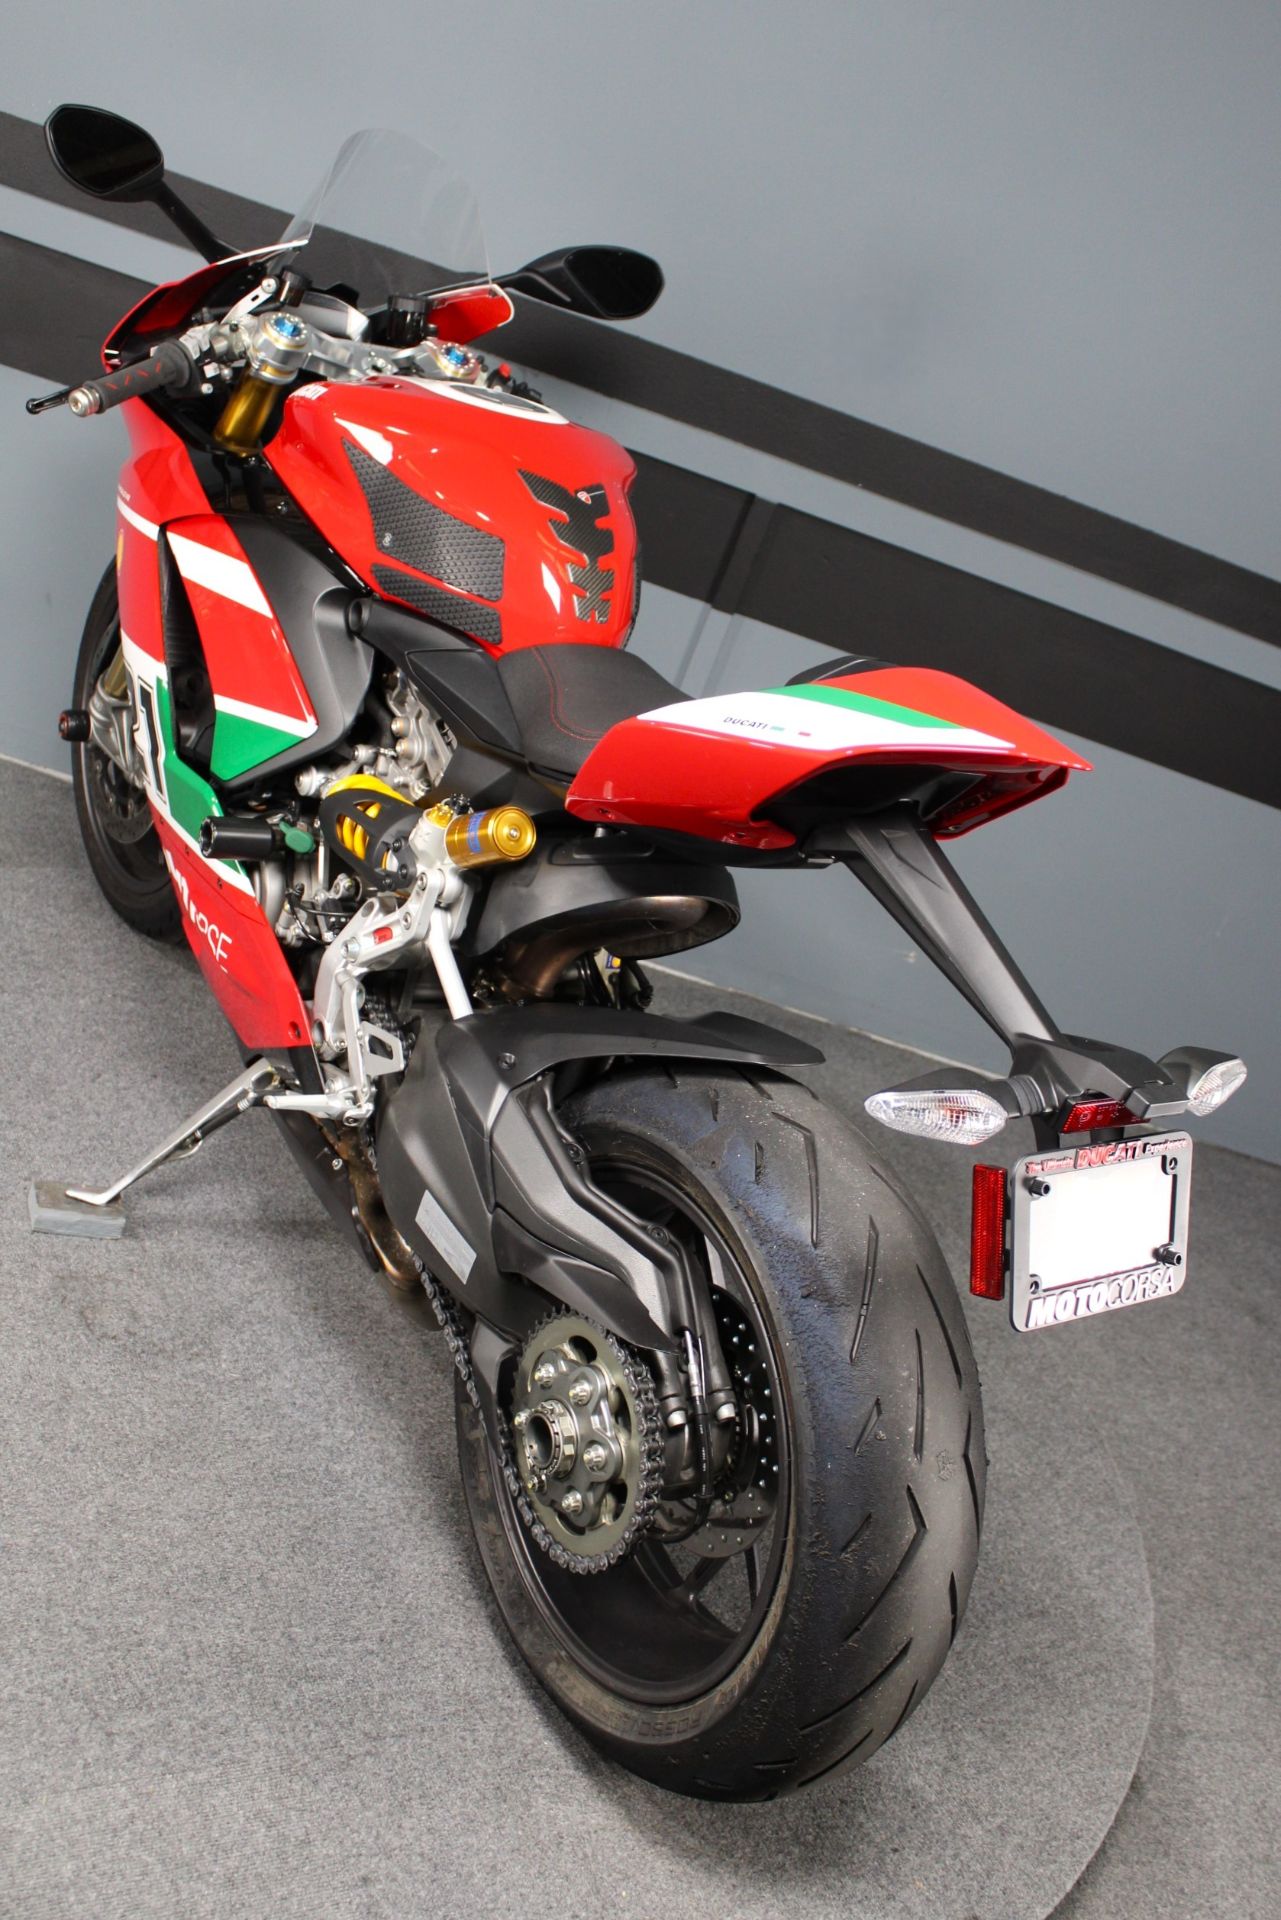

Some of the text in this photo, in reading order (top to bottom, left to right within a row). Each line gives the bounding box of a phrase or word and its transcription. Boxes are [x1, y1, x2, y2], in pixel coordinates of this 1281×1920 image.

[723, 716, 768, 730] DUCATI
[1076, 1139, 1144, 1169] DUCATI
[1026, 1266, 1175, 1328] MOTOCORSA
